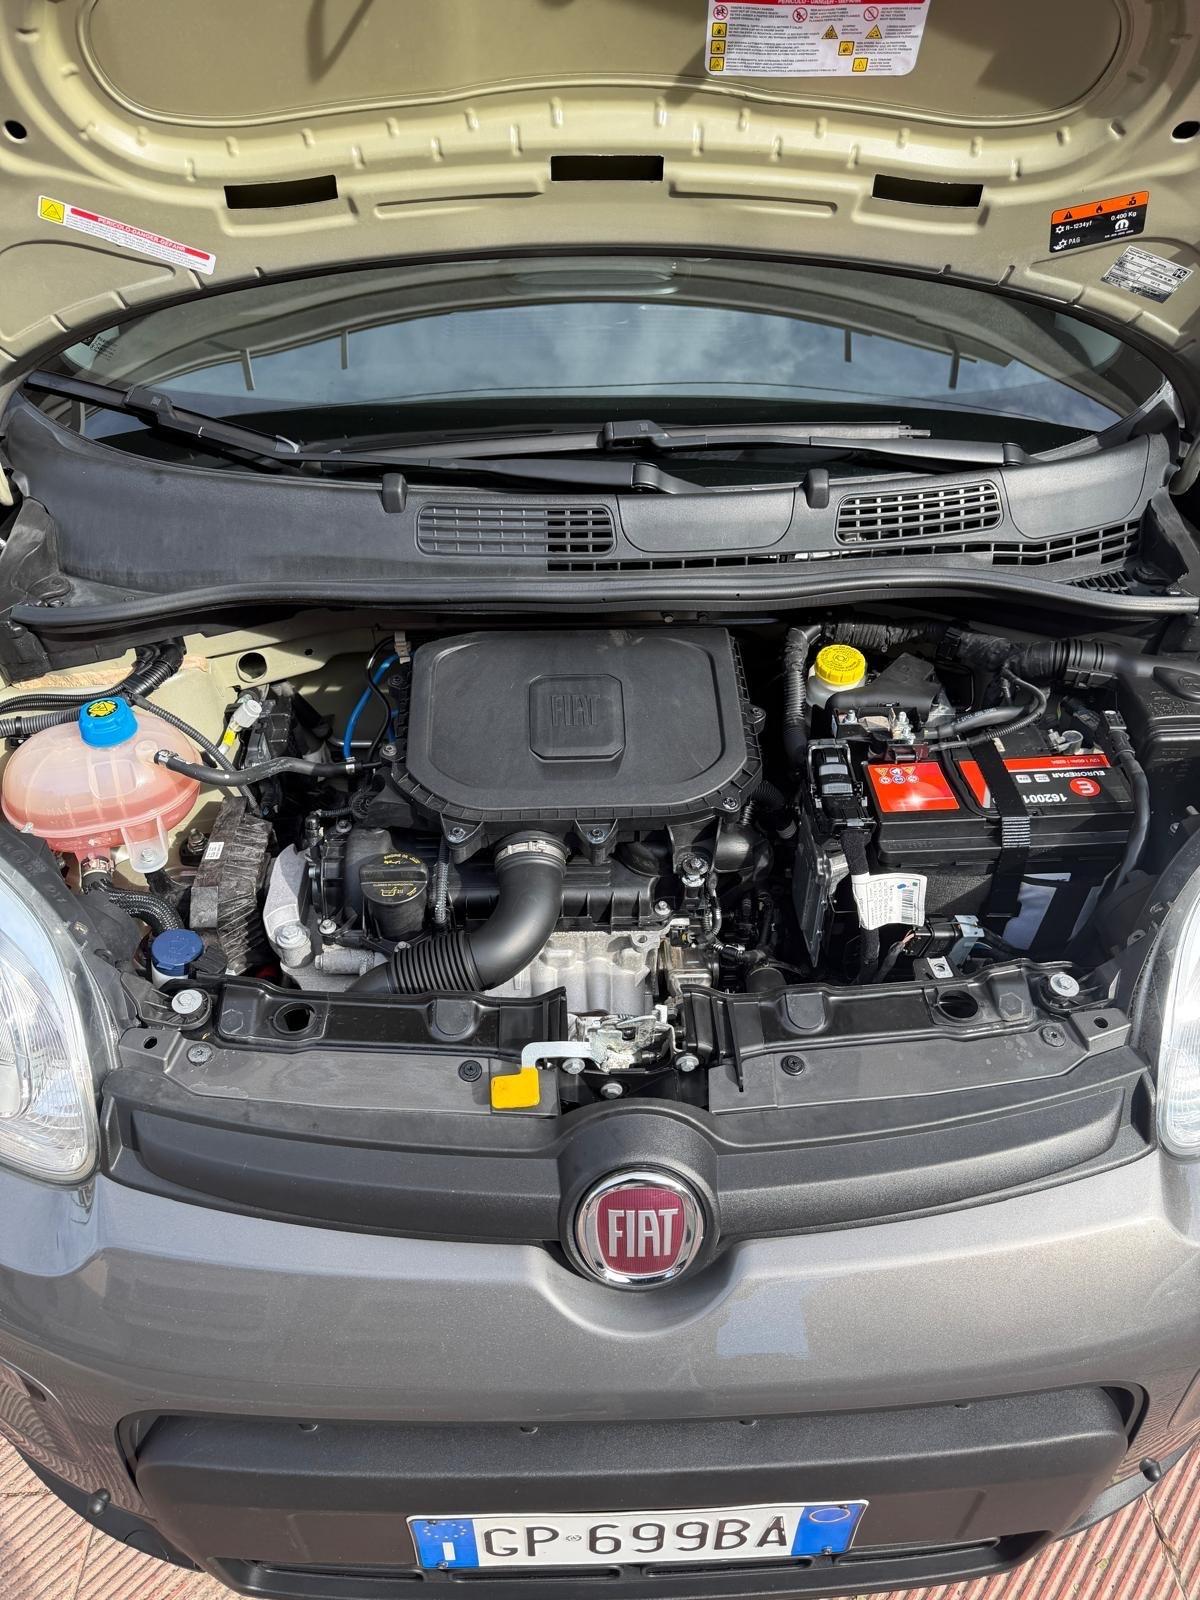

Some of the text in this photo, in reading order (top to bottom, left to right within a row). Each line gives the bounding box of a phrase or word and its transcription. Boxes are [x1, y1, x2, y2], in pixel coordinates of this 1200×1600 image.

[1111, 213, 1127, 222] 0.400
[1065, 220, 1093, 231] R-1234yf
[1068, 237, 1081, 245] PAG
[550, 694, 602, 728] FIAT
[1052, 770, 1106, 779] EUROREPAR
[1022, 793, 1068, 804] 162001
[607, 1208, 680, 1258] FIAT
[483, 1526, 560, 1558] GP
[587, 1515, 788, 1555] 699BA
